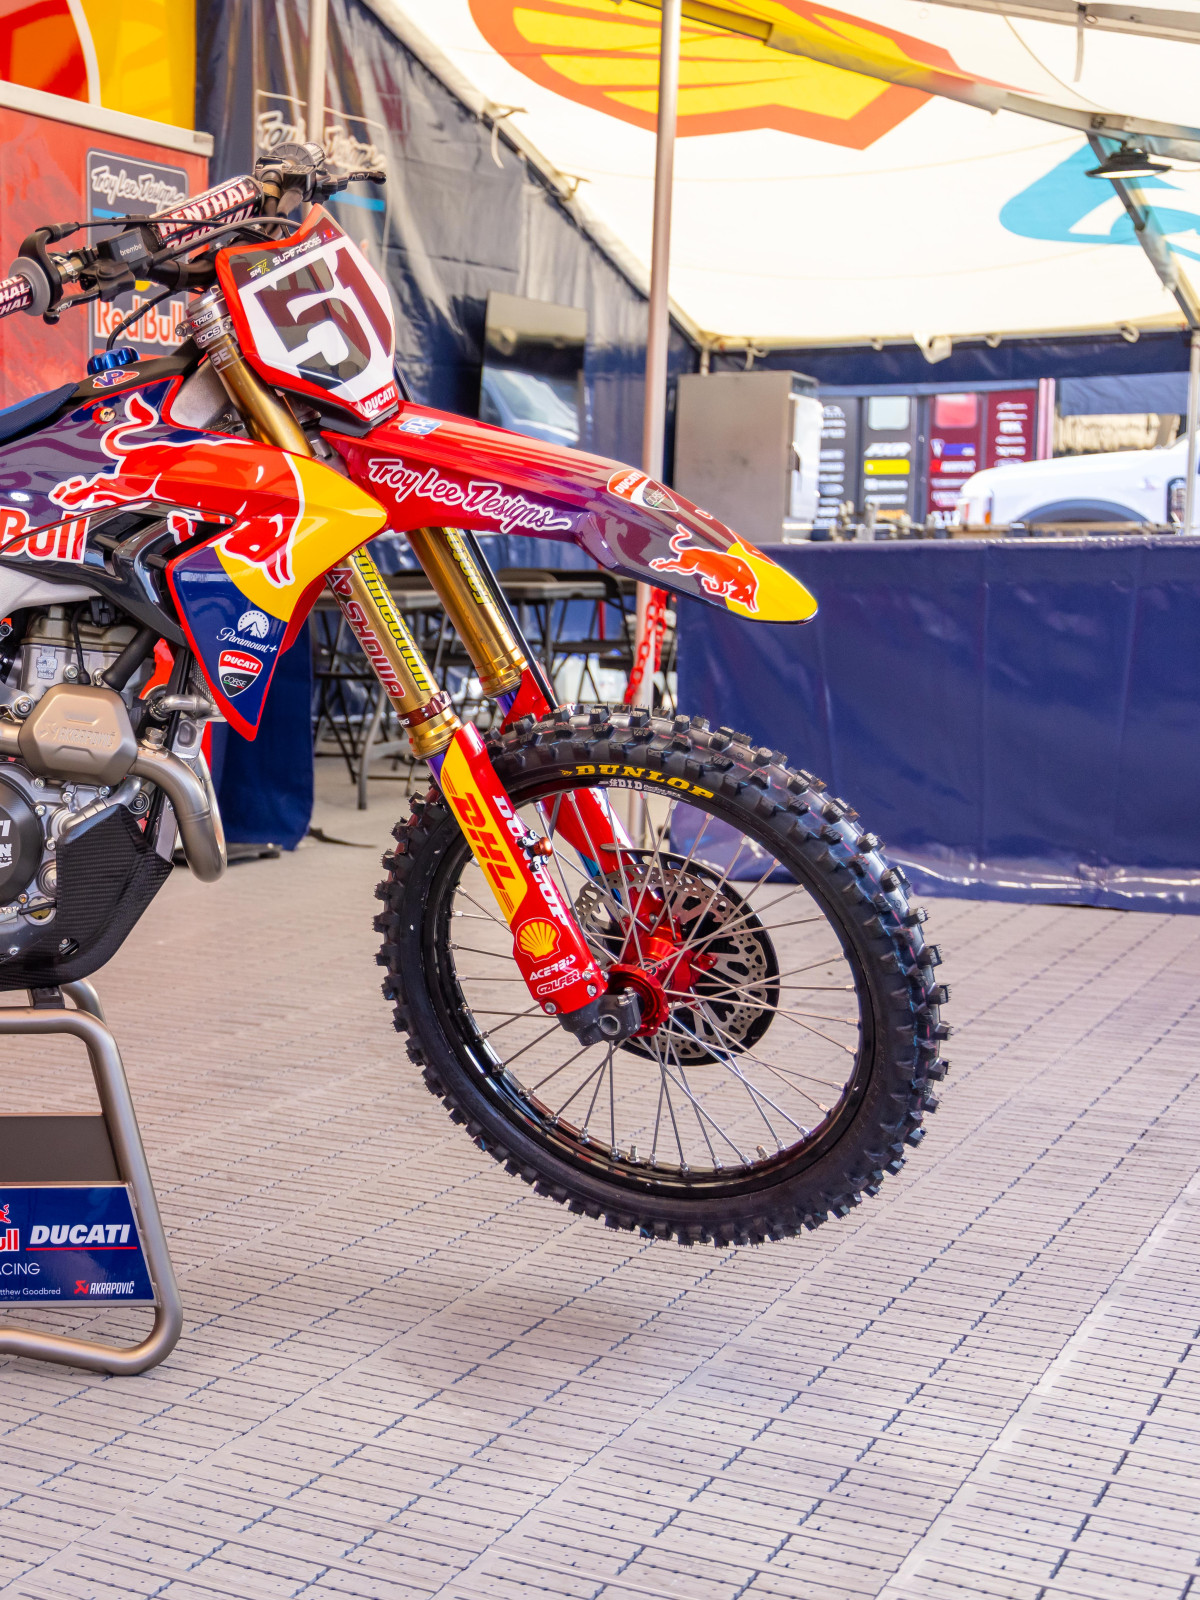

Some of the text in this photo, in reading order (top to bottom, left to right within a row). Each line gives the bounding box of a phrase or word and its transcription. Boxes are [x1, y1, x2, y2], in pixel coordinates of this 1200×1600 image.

[157, 182, 255, 238] RENTHAL
[120, 243, 143, 256] brembo
[273, 236, 321, 266] SUPERCROSS
[94, 295, 185, 346] Red Bull
[253, 246, 393, 390] 51
[94, 371, 124, 386] VP
[365, 388, 396, 413] DUCATI
[614, 471, 643, 494] DUCATI
[368, 458, 572, 534] Troy Lee Designs
[216, 627, 277, 653] Paramount+
[341, 600, 406, 698] SHOWA
[223, 654, 259, 671] DUCATI
[223, 674, 247, 688] CORSE
[575, 764, 714, 799] DUNLOP
[451, 792, 517, 891] DHL
[537, 969, 581, 995] GALFER
[29, 1224, 131, 1245] DUCATI
[22, 1287, 61, 1296] Goodbred
[90, 1281, 135, 1295] AKRAPOVIČ
